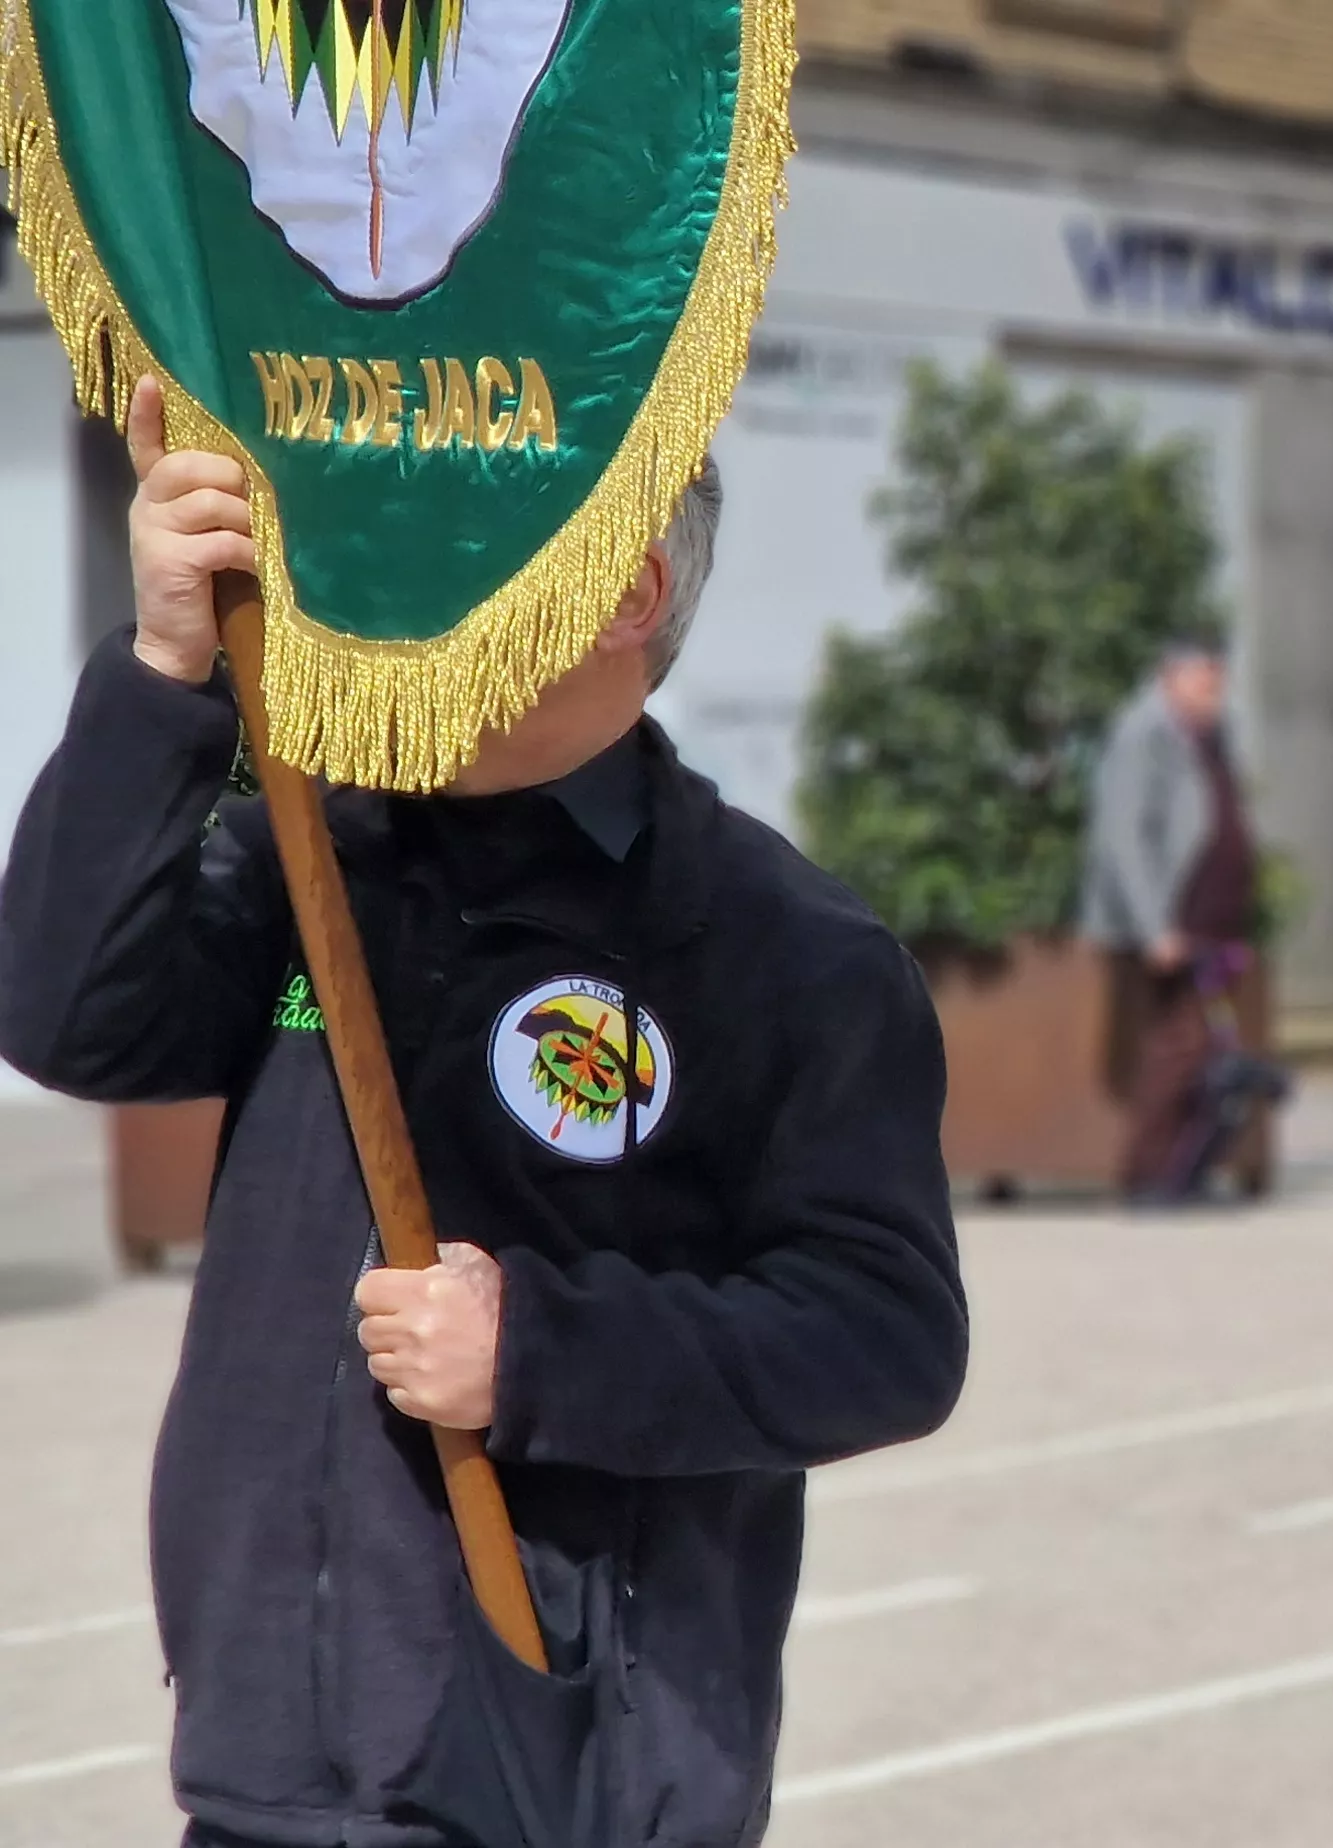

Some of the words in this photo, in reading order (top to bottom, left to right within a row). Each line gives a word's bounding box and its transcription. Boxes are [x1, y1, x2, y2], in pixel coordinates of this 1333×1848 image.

[250, 351, 334, 440] HOZ
[337, 357, 402, 447] DE
[414, 356, 557, 451] JACA
[568, 980, 588, 993] LA
